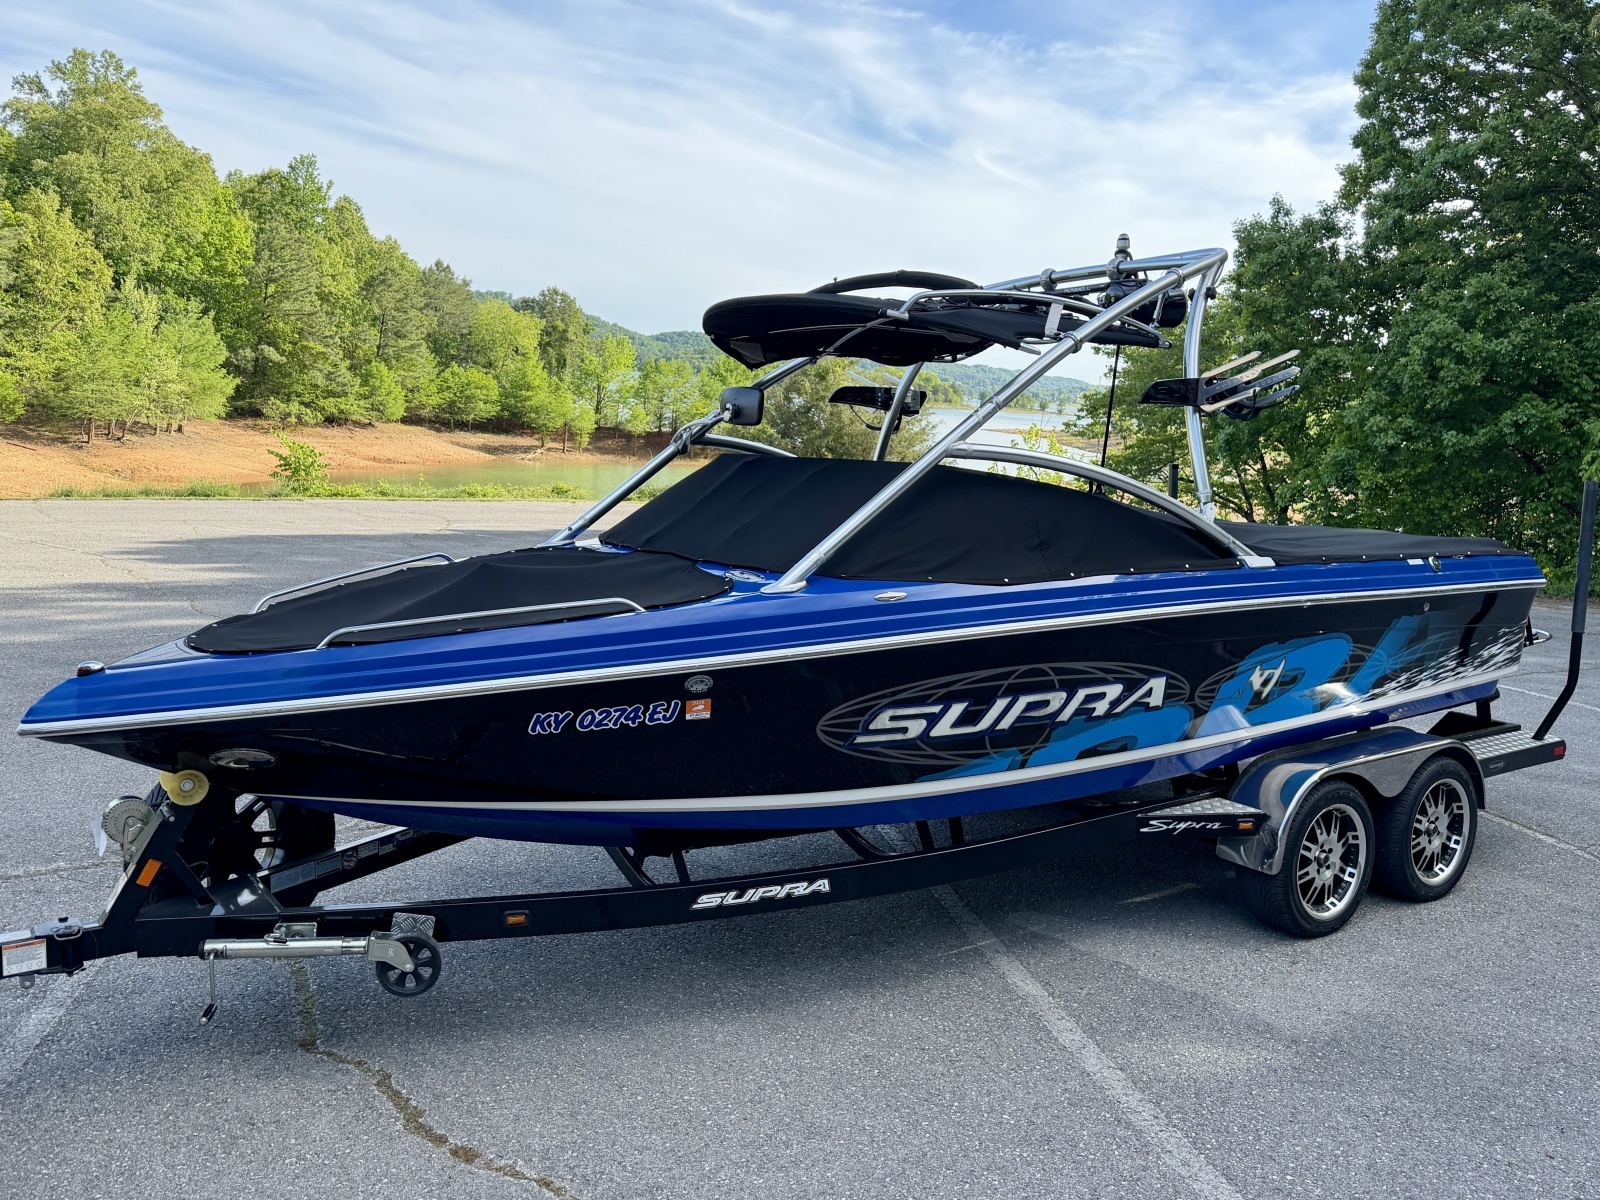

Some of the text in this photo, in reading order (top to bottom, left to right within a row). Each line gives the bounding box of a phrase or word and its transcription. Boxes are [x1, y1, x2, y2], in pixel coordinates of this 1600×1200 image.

[528, 700, 681, 735] KY 0274 EJ
[847, 674, 1167, 746] SUPRA
[1139, 819, 1232, 835] Supra
[690, 878, 831, 910] SUPRA
